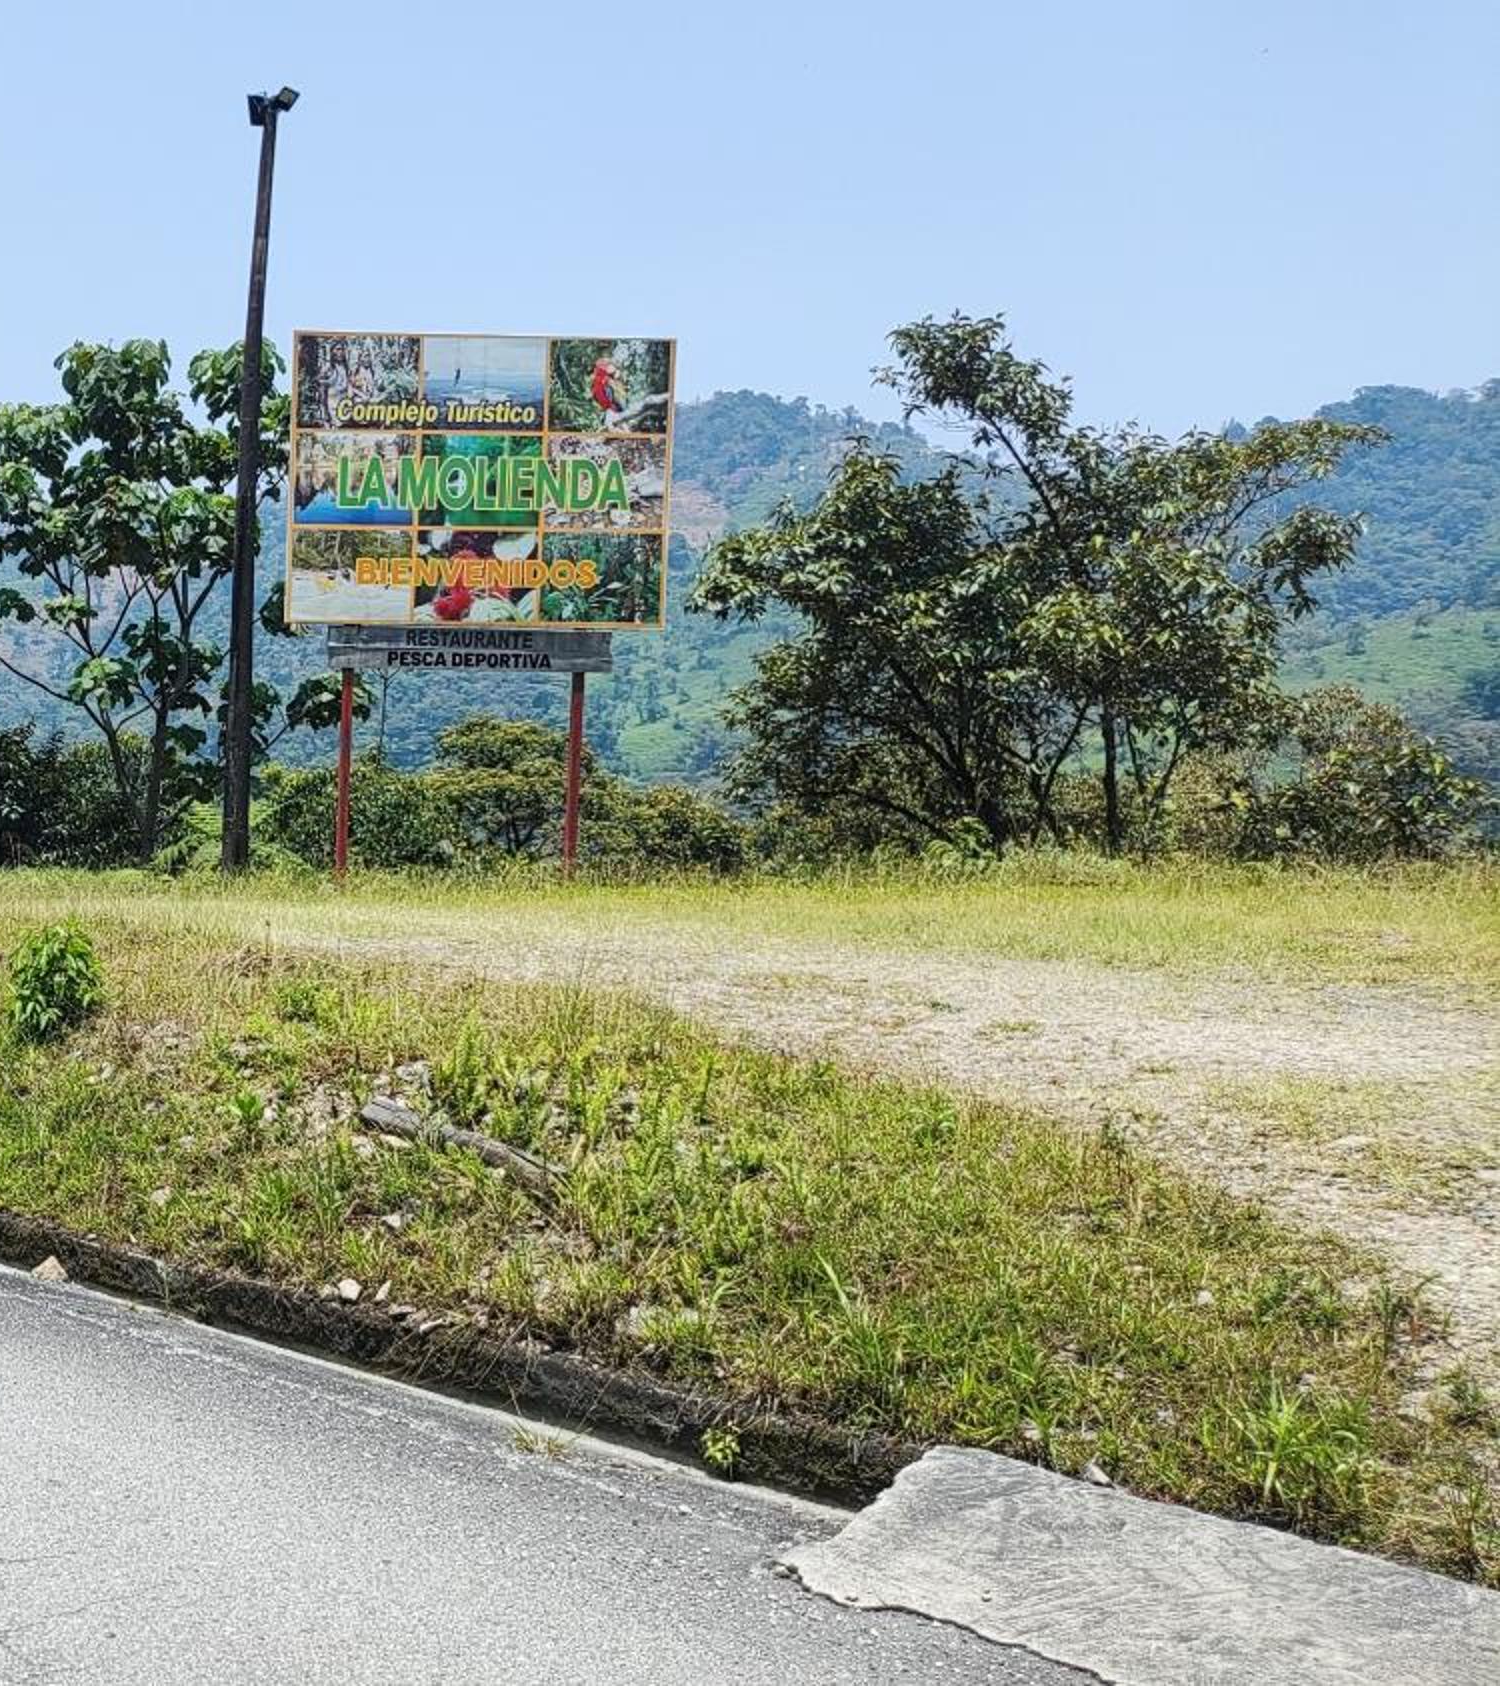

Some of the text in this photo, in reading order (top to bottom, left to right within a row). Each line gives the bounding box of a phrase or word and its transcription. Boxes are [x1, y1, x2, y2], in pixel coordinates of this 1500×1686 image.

[336, 399, 438, 427] Complejo
[335, 455, 631, 512] LA MOLIENDA
[355, 557, 598, 589] BIENVENIDOS
[405, 630, 534, 649] RESTAURANTE
[387, 650, 552, 669] PESCA DEPORTIVA
